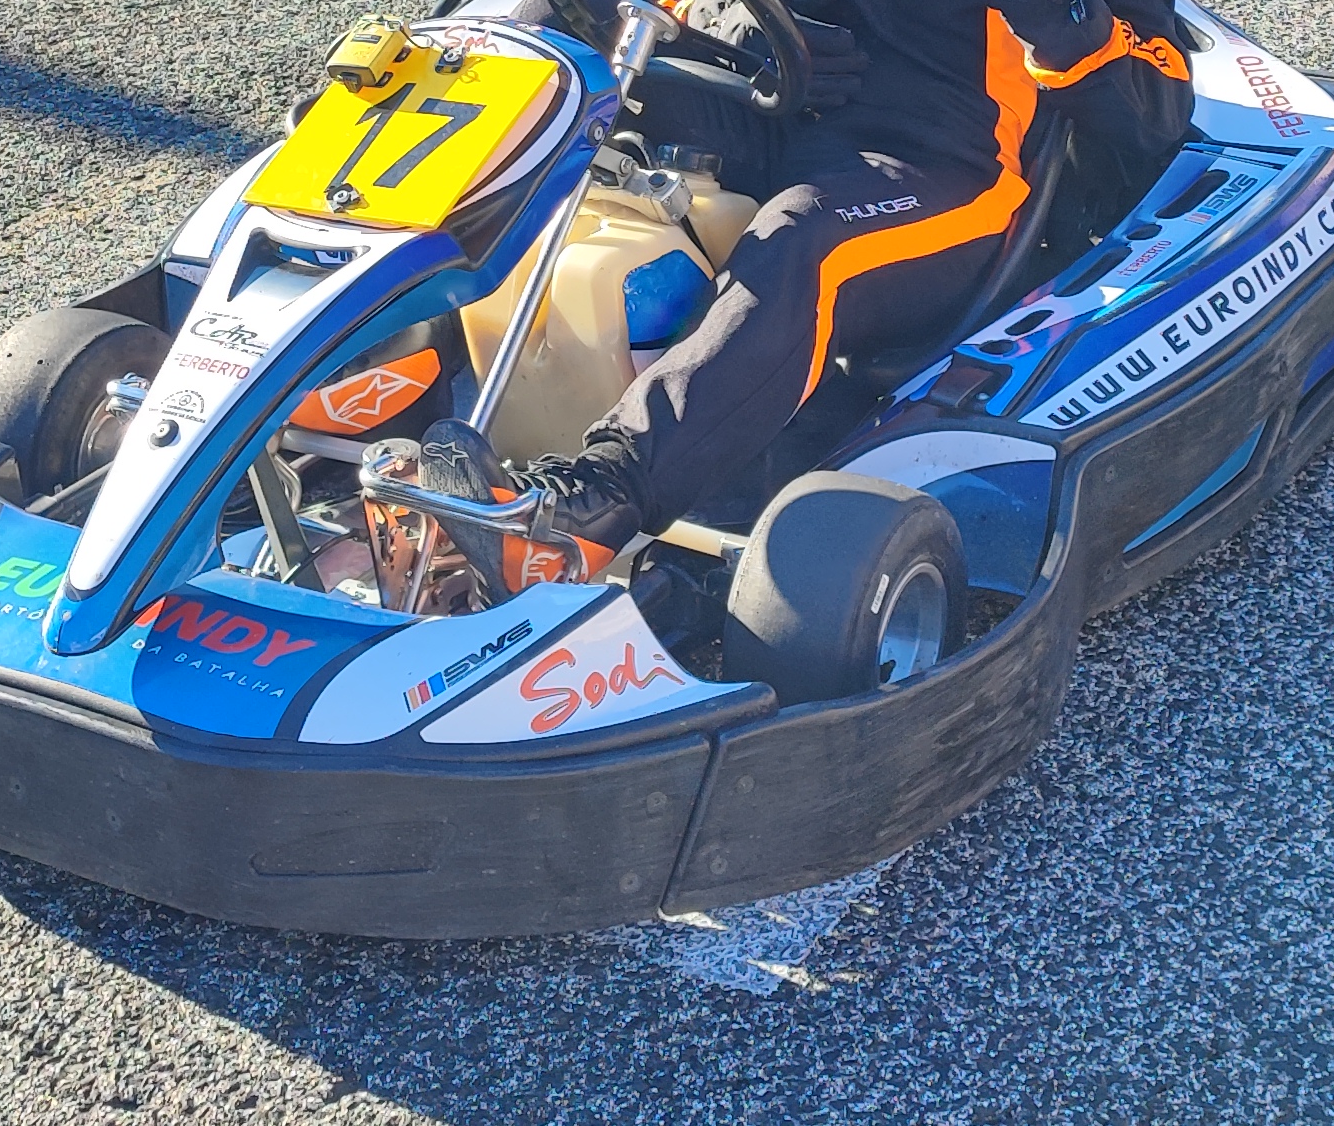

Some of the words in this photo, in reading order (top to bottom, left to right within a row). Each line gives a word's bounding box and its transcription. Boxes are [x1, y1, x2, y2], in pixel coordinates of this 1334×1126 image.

[1235, 55, 1311, 138] FERBERTO
[324, 82, 487, 192] 17
[834, 194, 923, 223] THUNDER
[1117, 239, 1172, 278] FERBERTO
[132, 637, 160, 656] DA
[174, 652, 285, 698] BATALHA
[442, 618, 534, 680] SWS
[519, 642, 686, 735] Sodi
